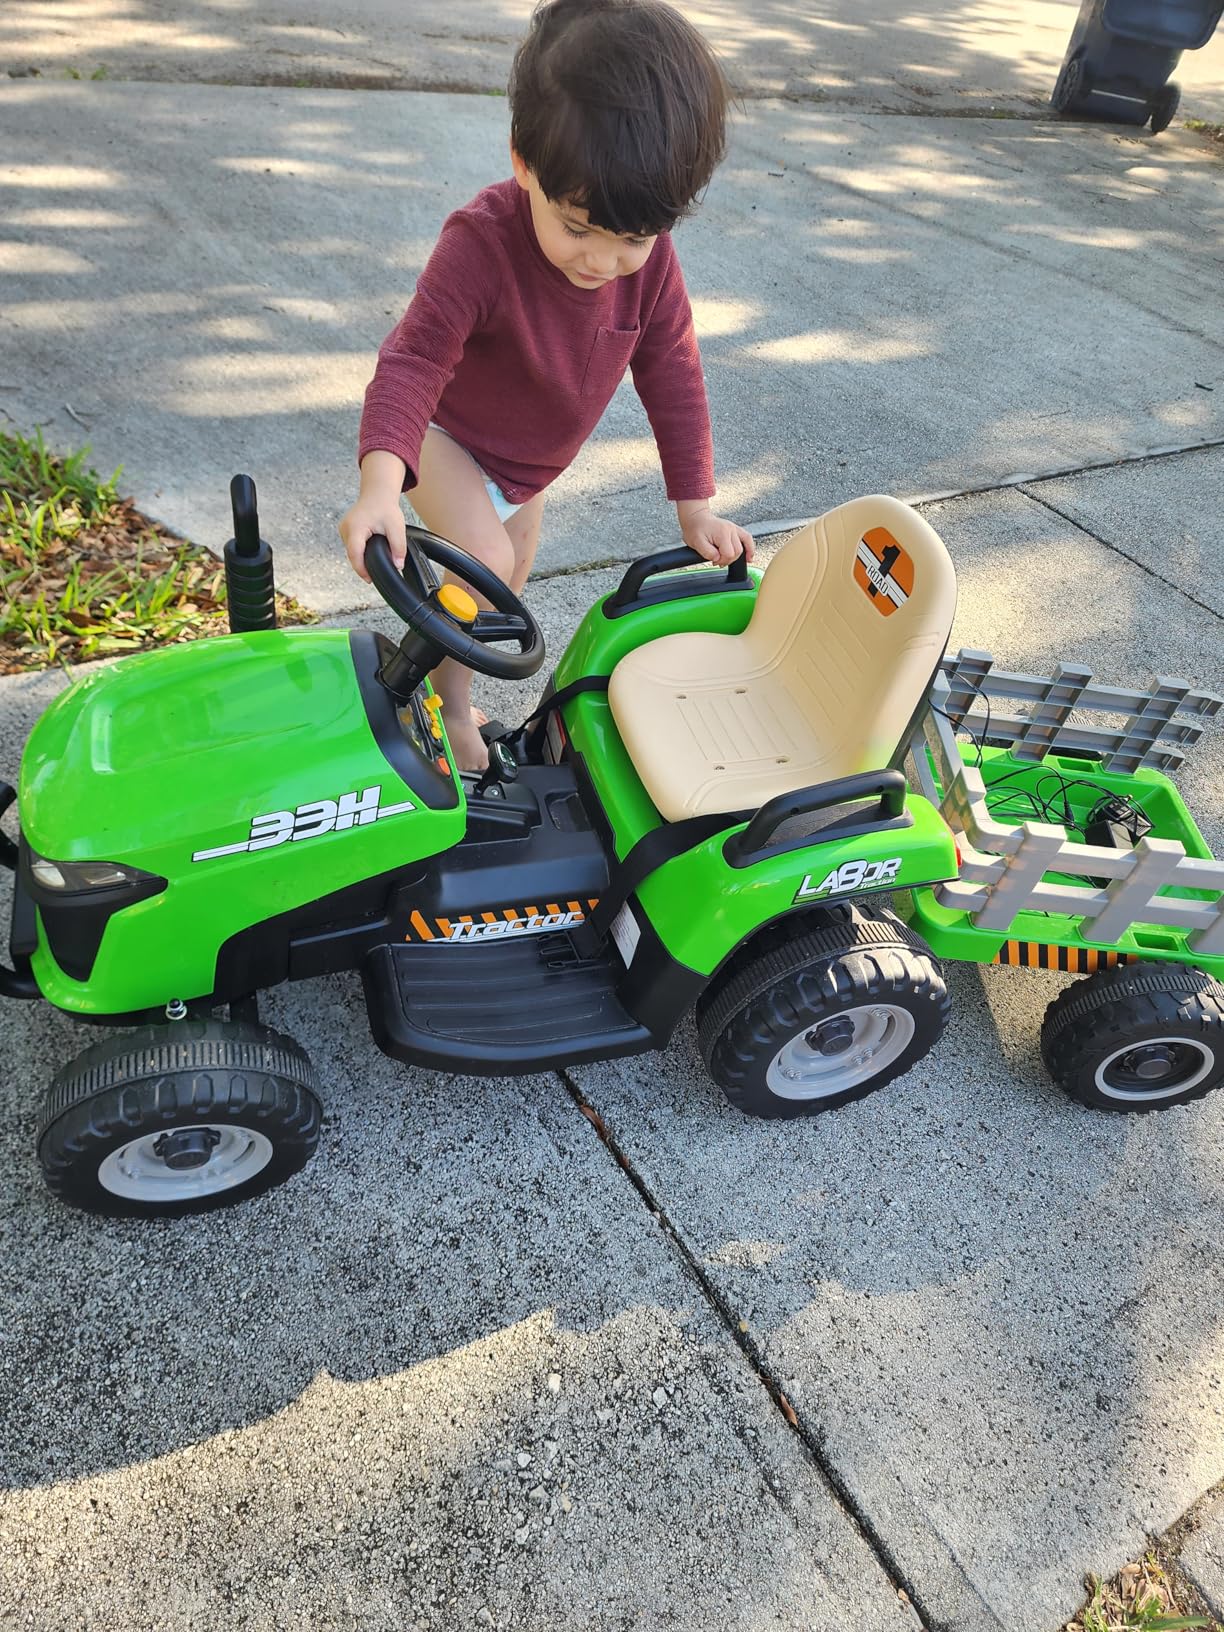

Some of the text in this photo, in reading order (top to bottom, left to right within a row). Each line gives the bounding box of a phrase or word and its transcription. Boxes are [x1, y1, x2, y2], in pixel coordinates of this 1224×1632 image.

[867, 565, 889, 594] ROAD
[248, 785, 382, 852] 33H
[450, 911, 582, 940] Tractor
